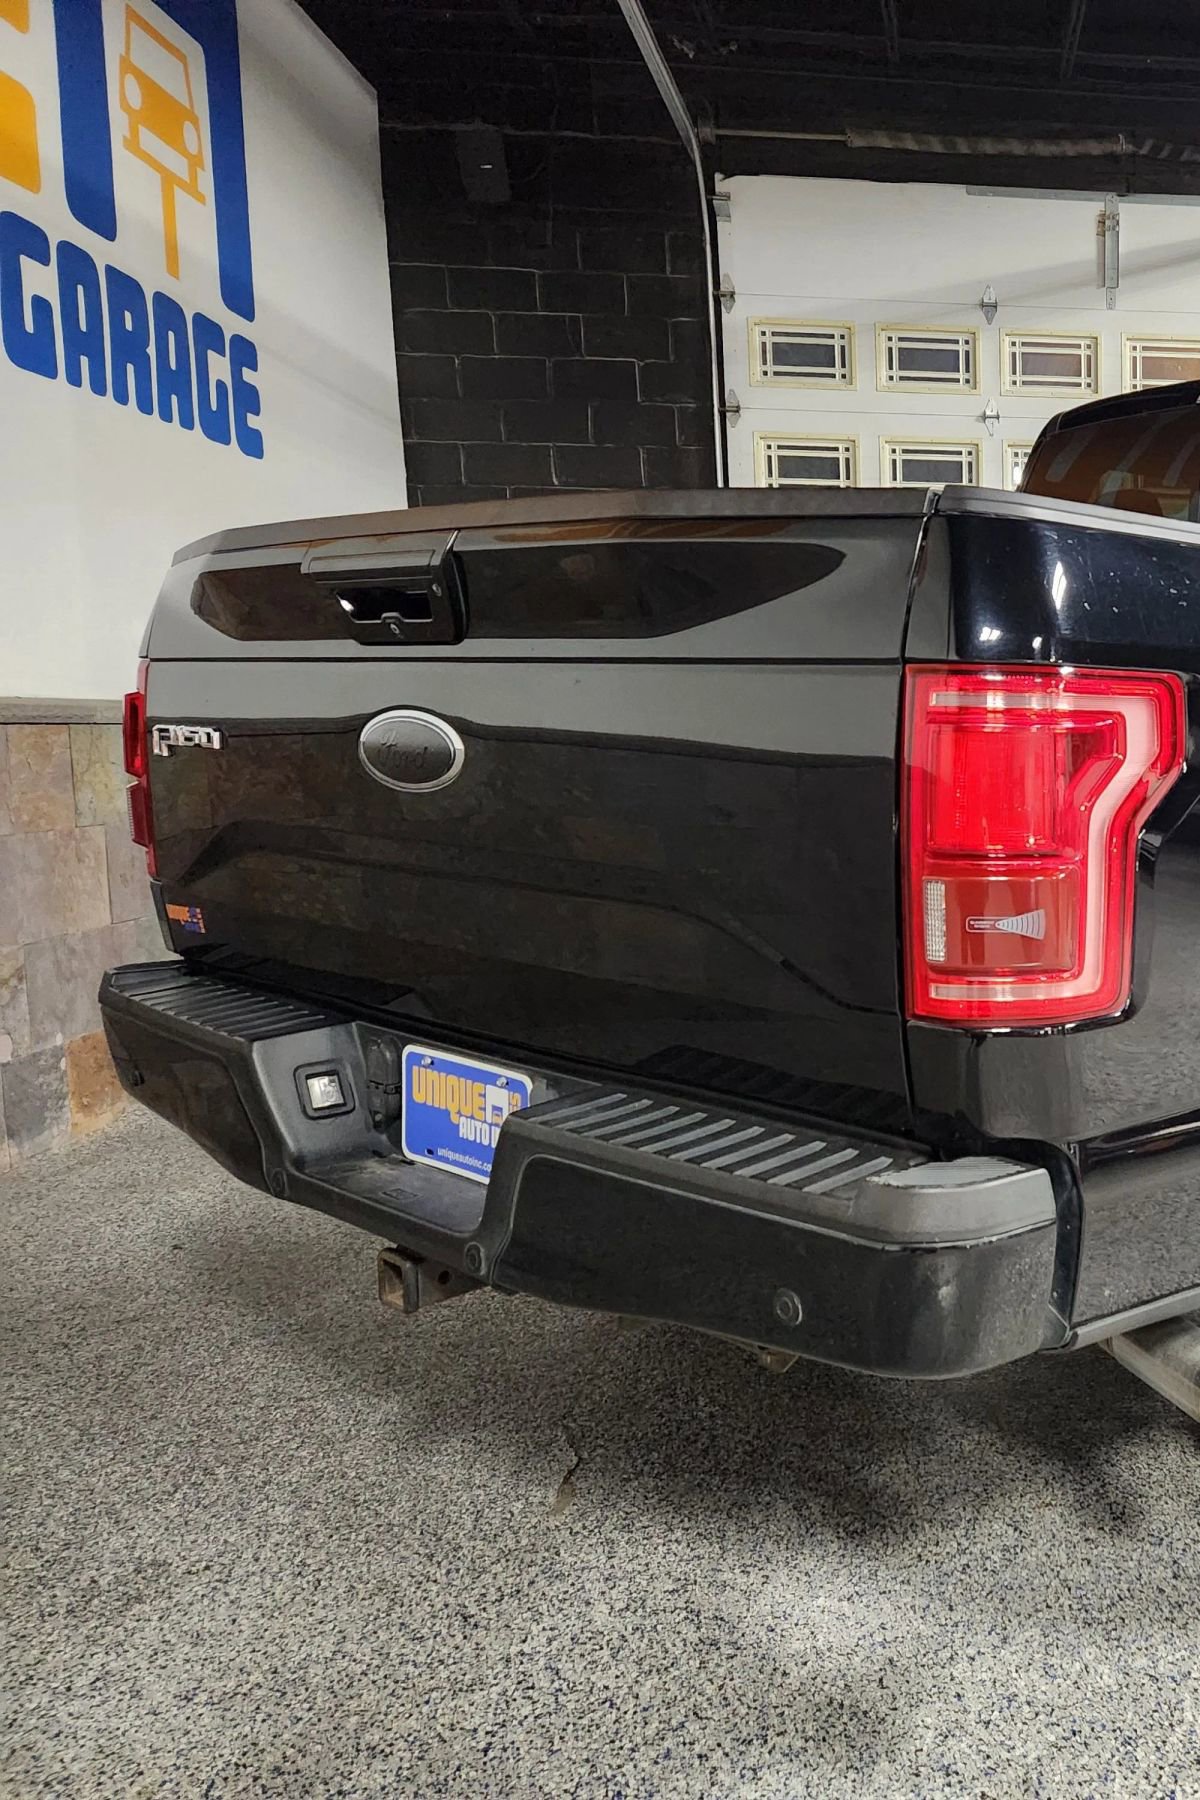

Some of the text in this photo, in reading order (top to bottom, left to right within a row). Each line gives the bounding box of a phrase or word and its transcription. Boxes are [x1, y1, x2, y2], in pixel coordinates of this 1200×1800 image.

[0, 211, 264, 459] GARAGE
[376, 729, 430, 769] Ford
[412, 1065, 485, 1124] UNIQUE
[459, 1116, 490, 1146] AUTO
[437, 1147, 492, 1172] uniqueautoinc.co
